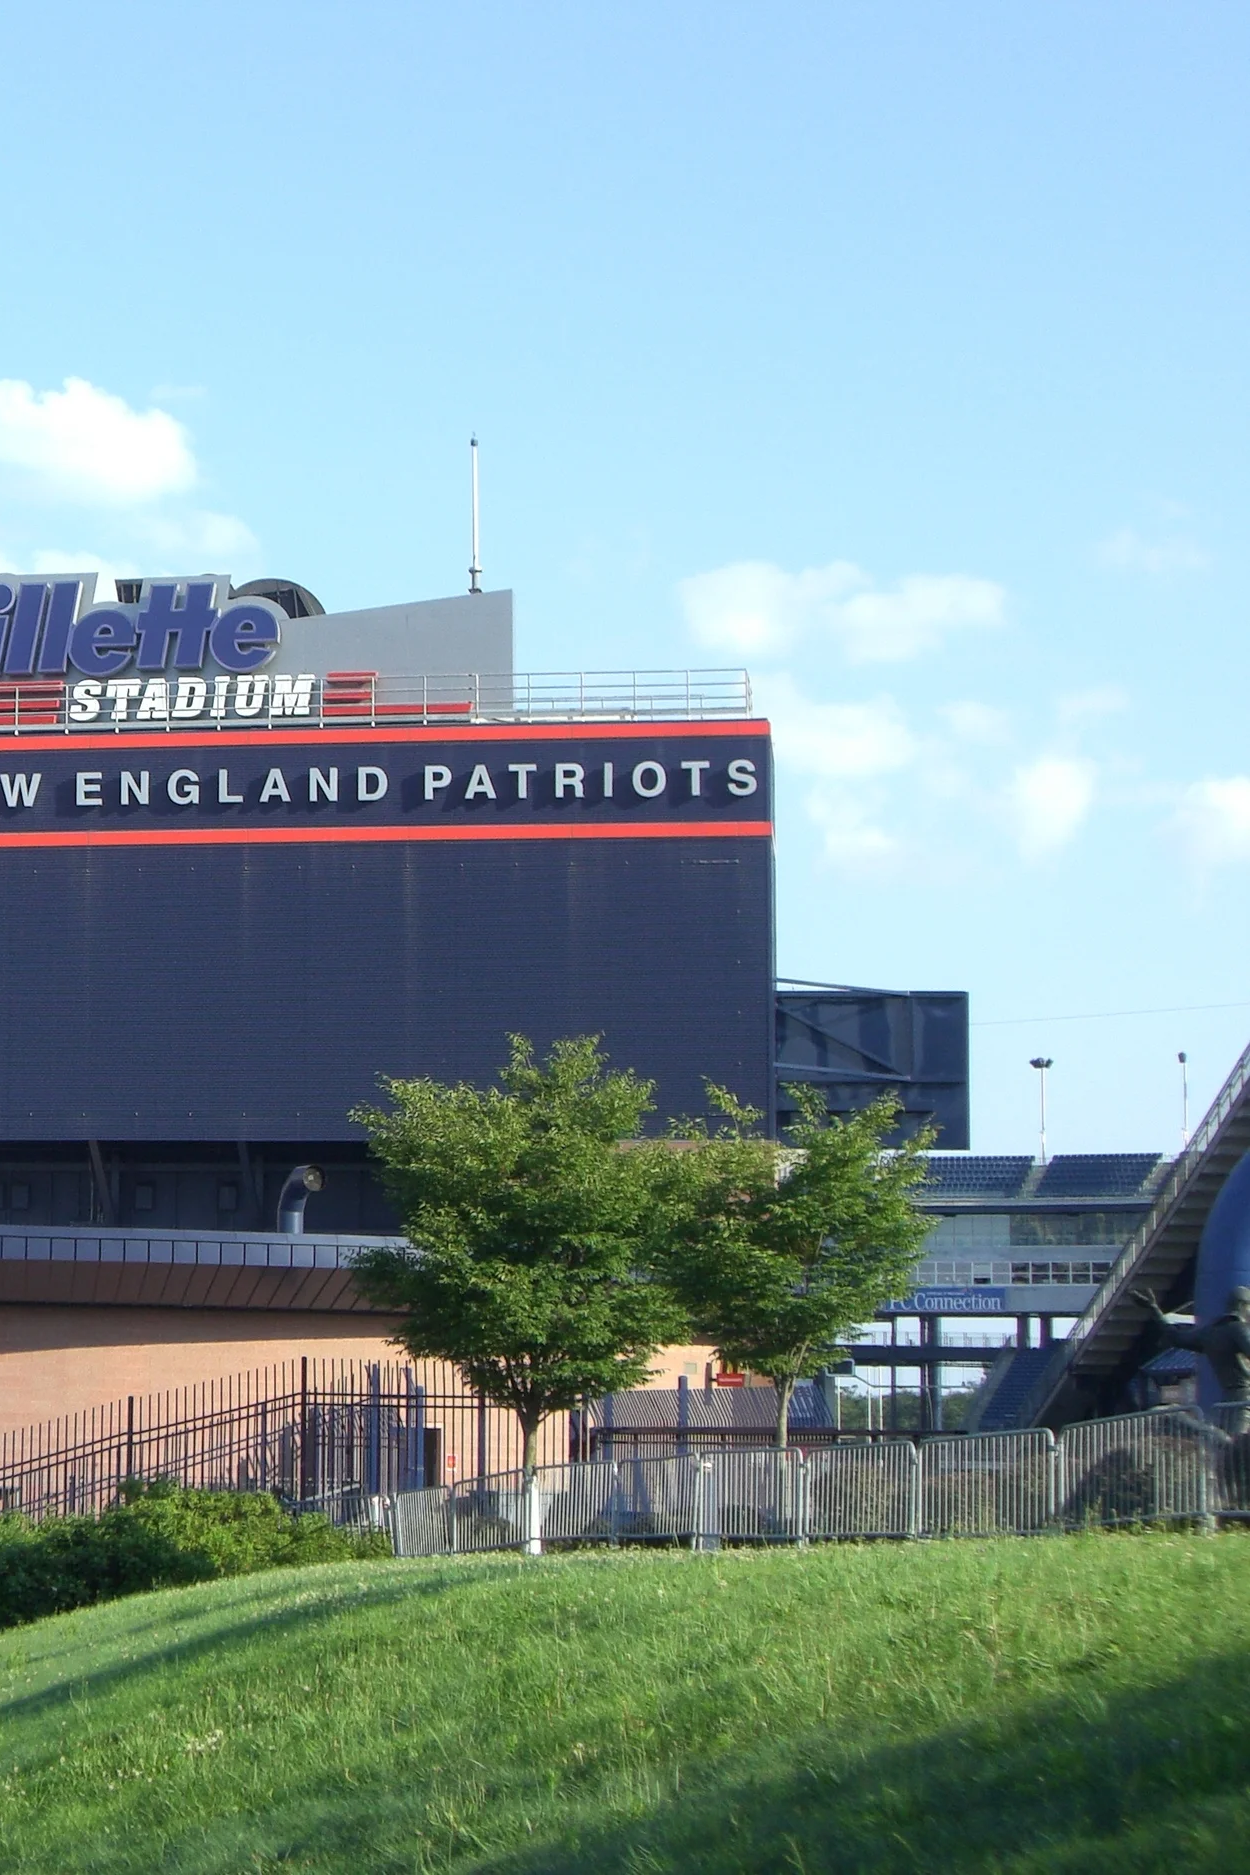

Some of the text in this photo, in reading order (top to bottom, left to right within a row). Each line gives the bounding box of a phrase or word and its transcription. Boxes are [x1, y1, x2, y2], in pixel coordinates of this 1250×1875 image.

[69, 673, 316, 723] STADIUM
[76, 767, 388, 806] ENGLAND
[424, 760, 758, 800] PATRIOTS
[914, 1292, 1001, 1310] Connection
